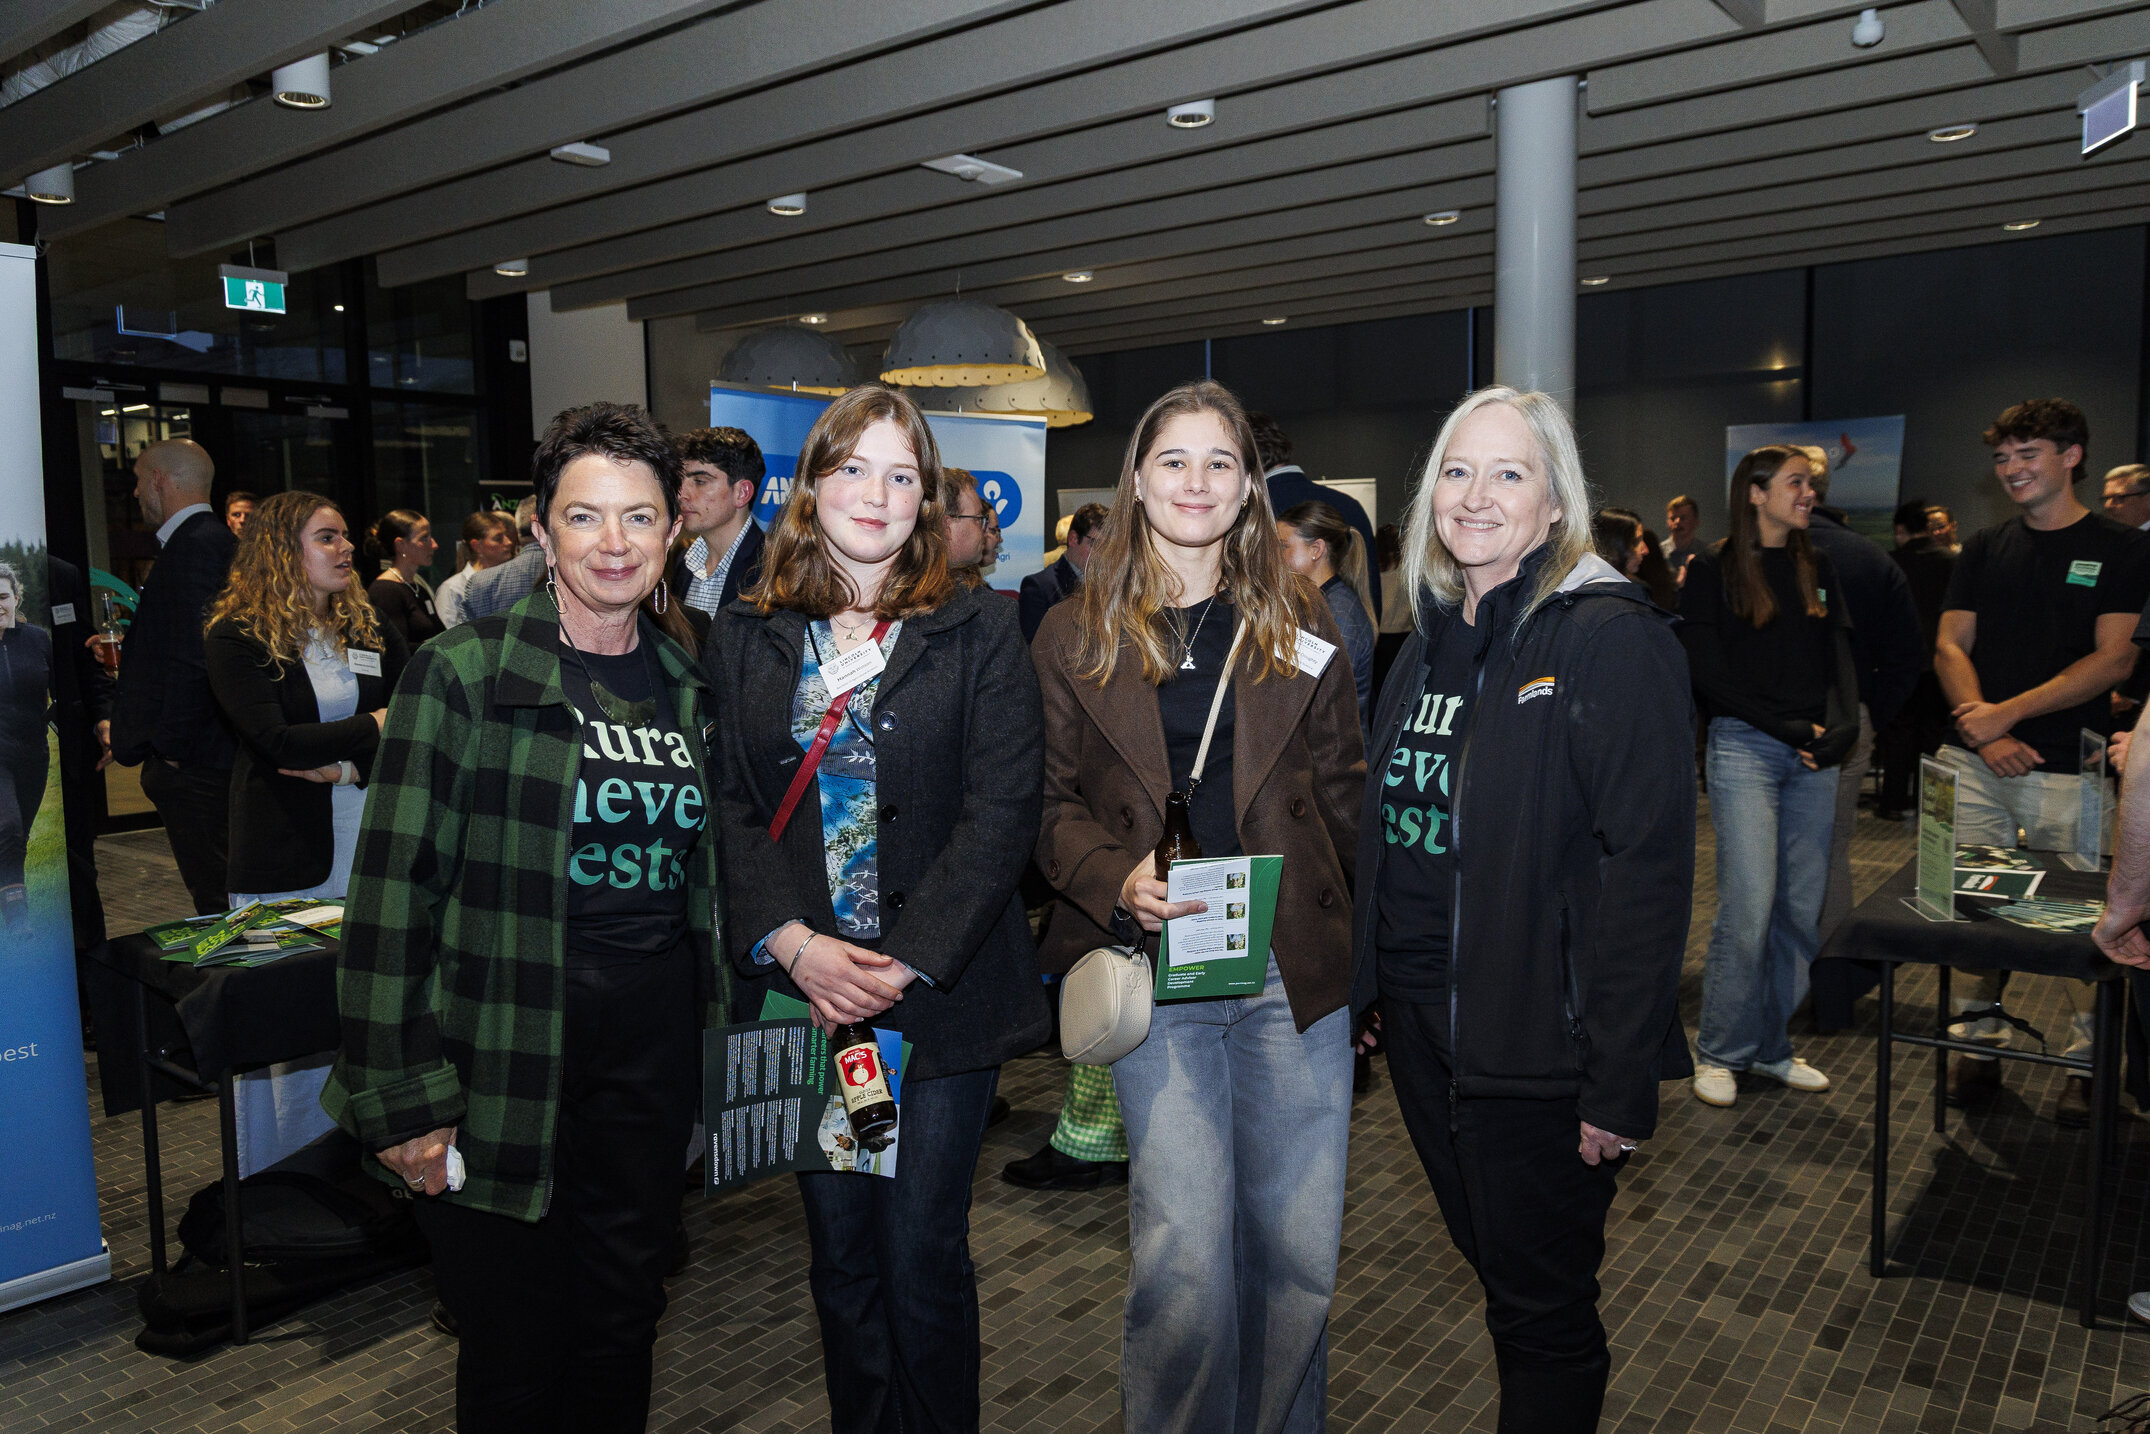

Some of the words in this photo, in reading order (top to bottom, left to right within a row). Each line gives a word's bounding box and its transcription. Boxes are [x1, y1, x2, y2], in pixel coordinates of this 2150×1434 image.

[1517, 686, 1553, 705] Farmlands
[1403, 684, 1463, 736] ur
[573, 706, 696, 770] ura
[573, 777, 707, 832] eve
[1168, 965, 1205, 973] EMPOWER
[0, 1042, 39, 1062] est
[844, 1051, 867, 1065] MAC'S
[807, 1056, 817, 1086] farming
[851, 1094, 866, 1104] APPLE
[867, 1088, 883, 1097] CIDER
